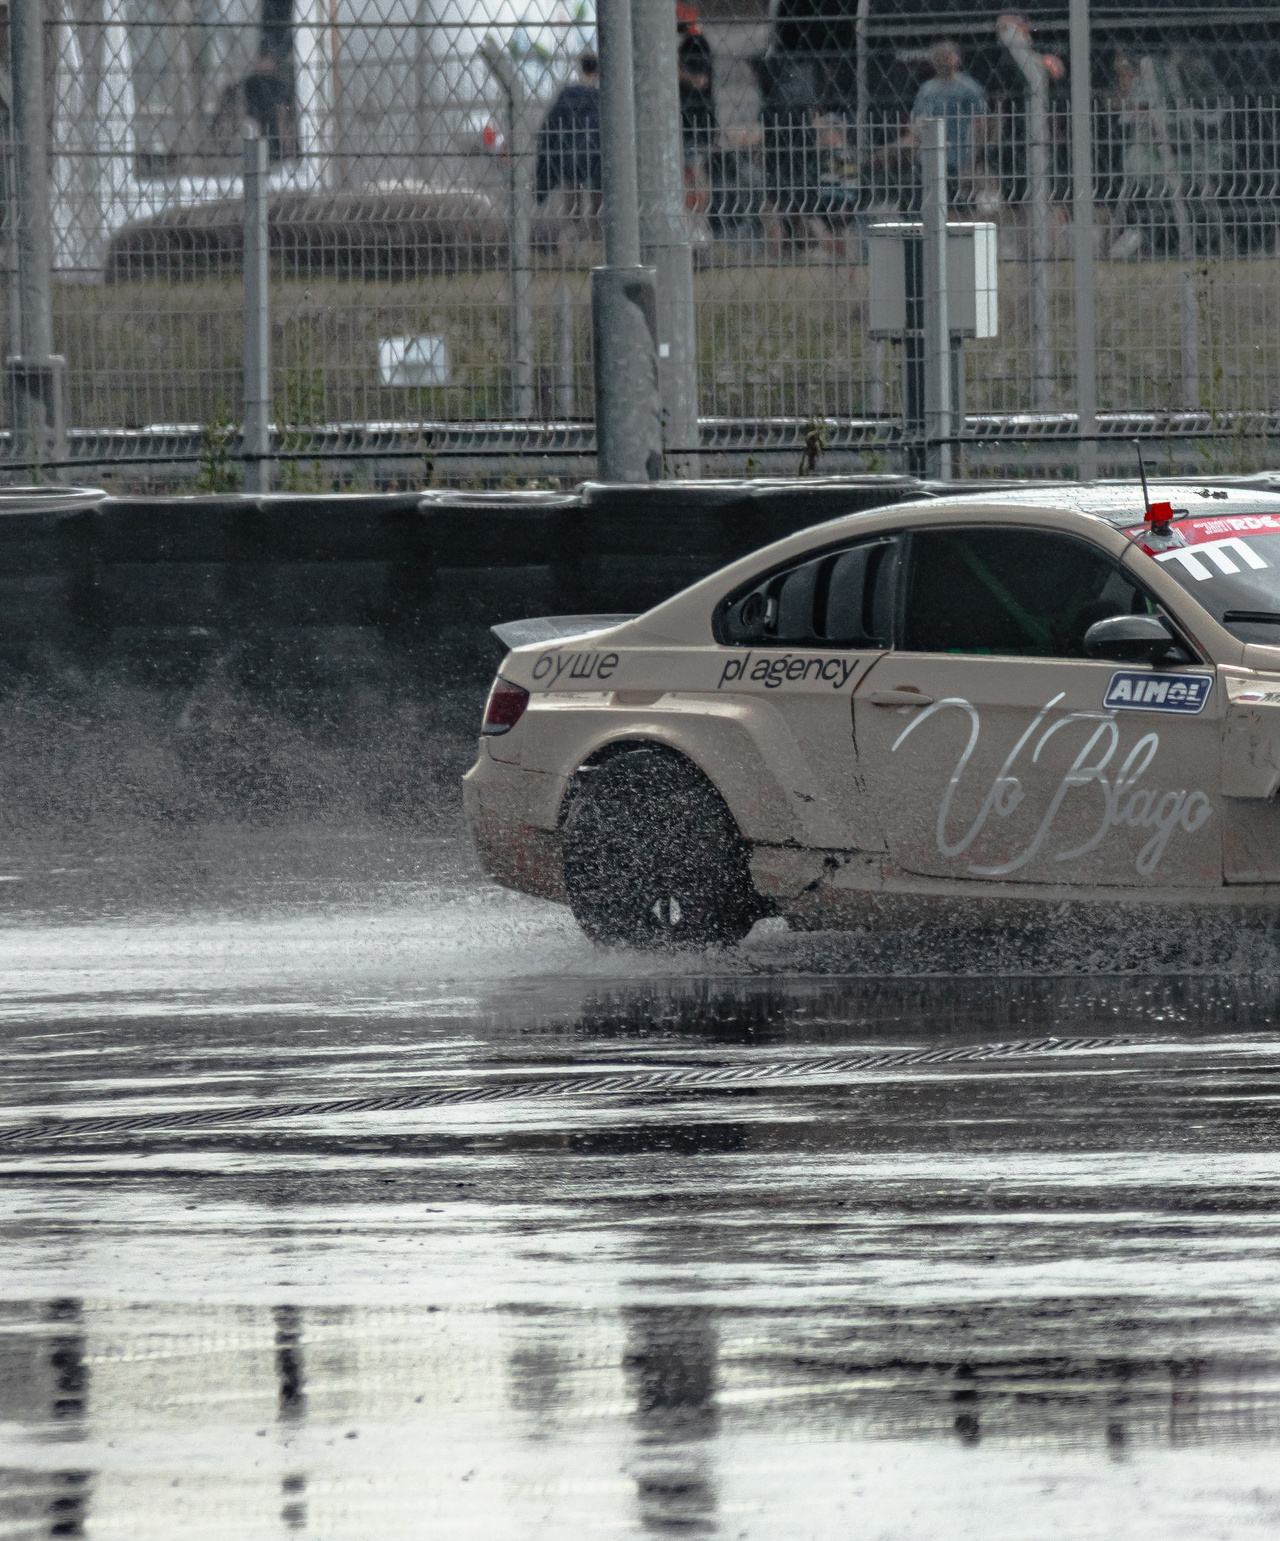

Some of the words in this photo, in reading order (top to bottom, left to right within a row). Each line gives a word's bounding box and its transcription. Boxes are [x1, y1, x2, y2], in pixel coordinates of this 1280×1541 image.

[532, 645, 619, 688] буше
[717, 651, 751, 689] pl
[750, 654, 859, 689] agency
[1107, 679, 1201, 706] AIMOL
[891, 692, 1066, 857] Vo
[968, 709, 1214, 876] Blago
